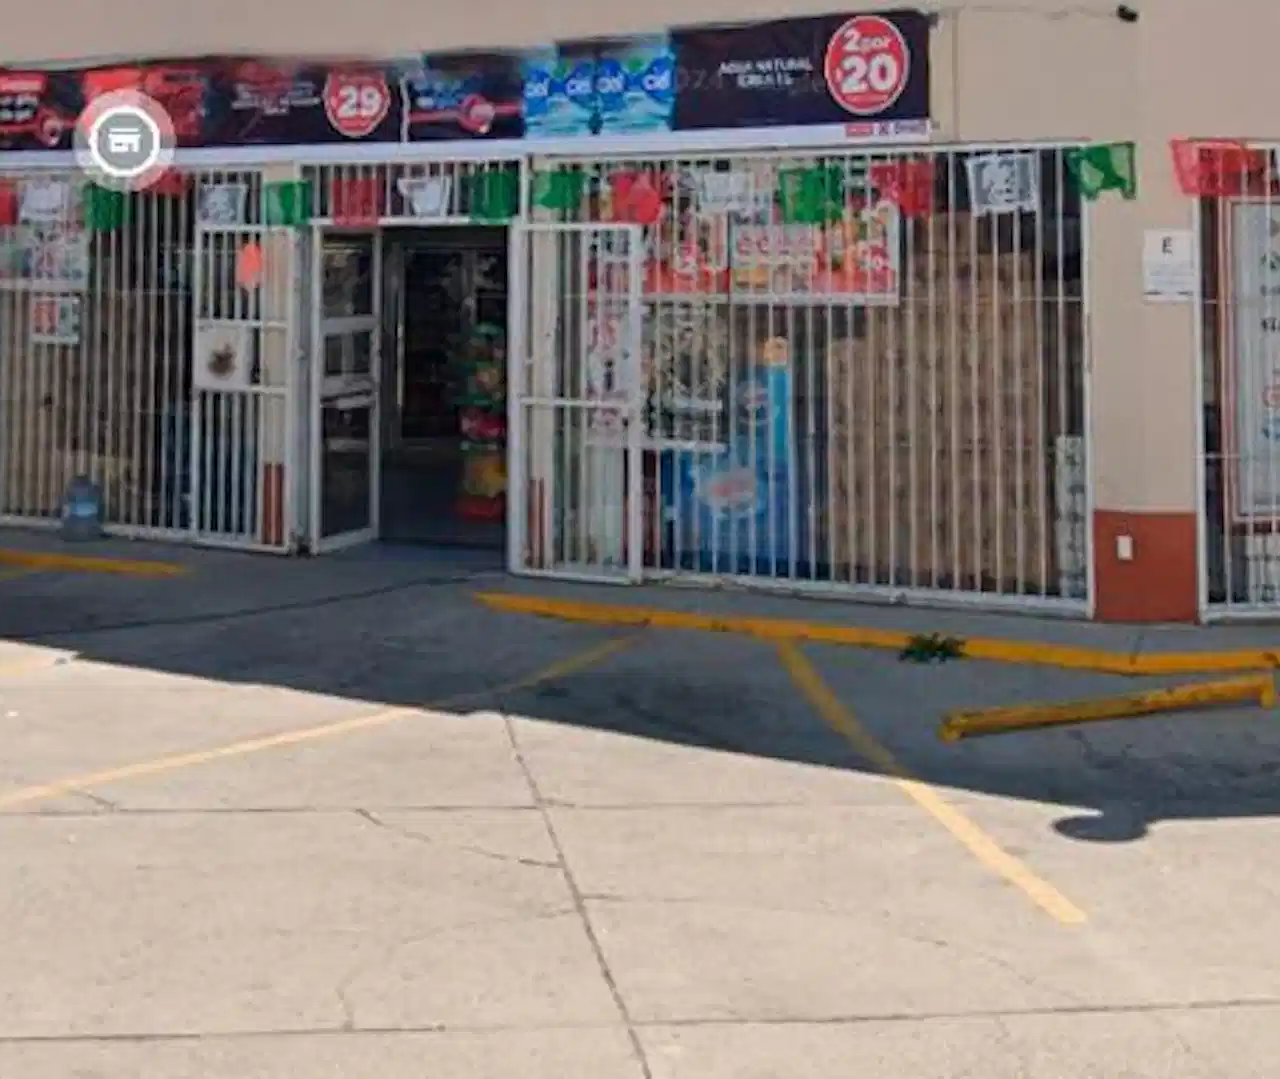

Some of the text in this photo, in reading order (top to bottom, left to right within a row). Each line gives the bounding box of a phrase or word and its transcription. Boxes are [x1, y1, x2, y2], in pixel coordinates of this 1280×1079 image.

[843, 28, 862, 51] 2
[840, 53, 898, 93] 20
[337, 85, 384, 117] 29
